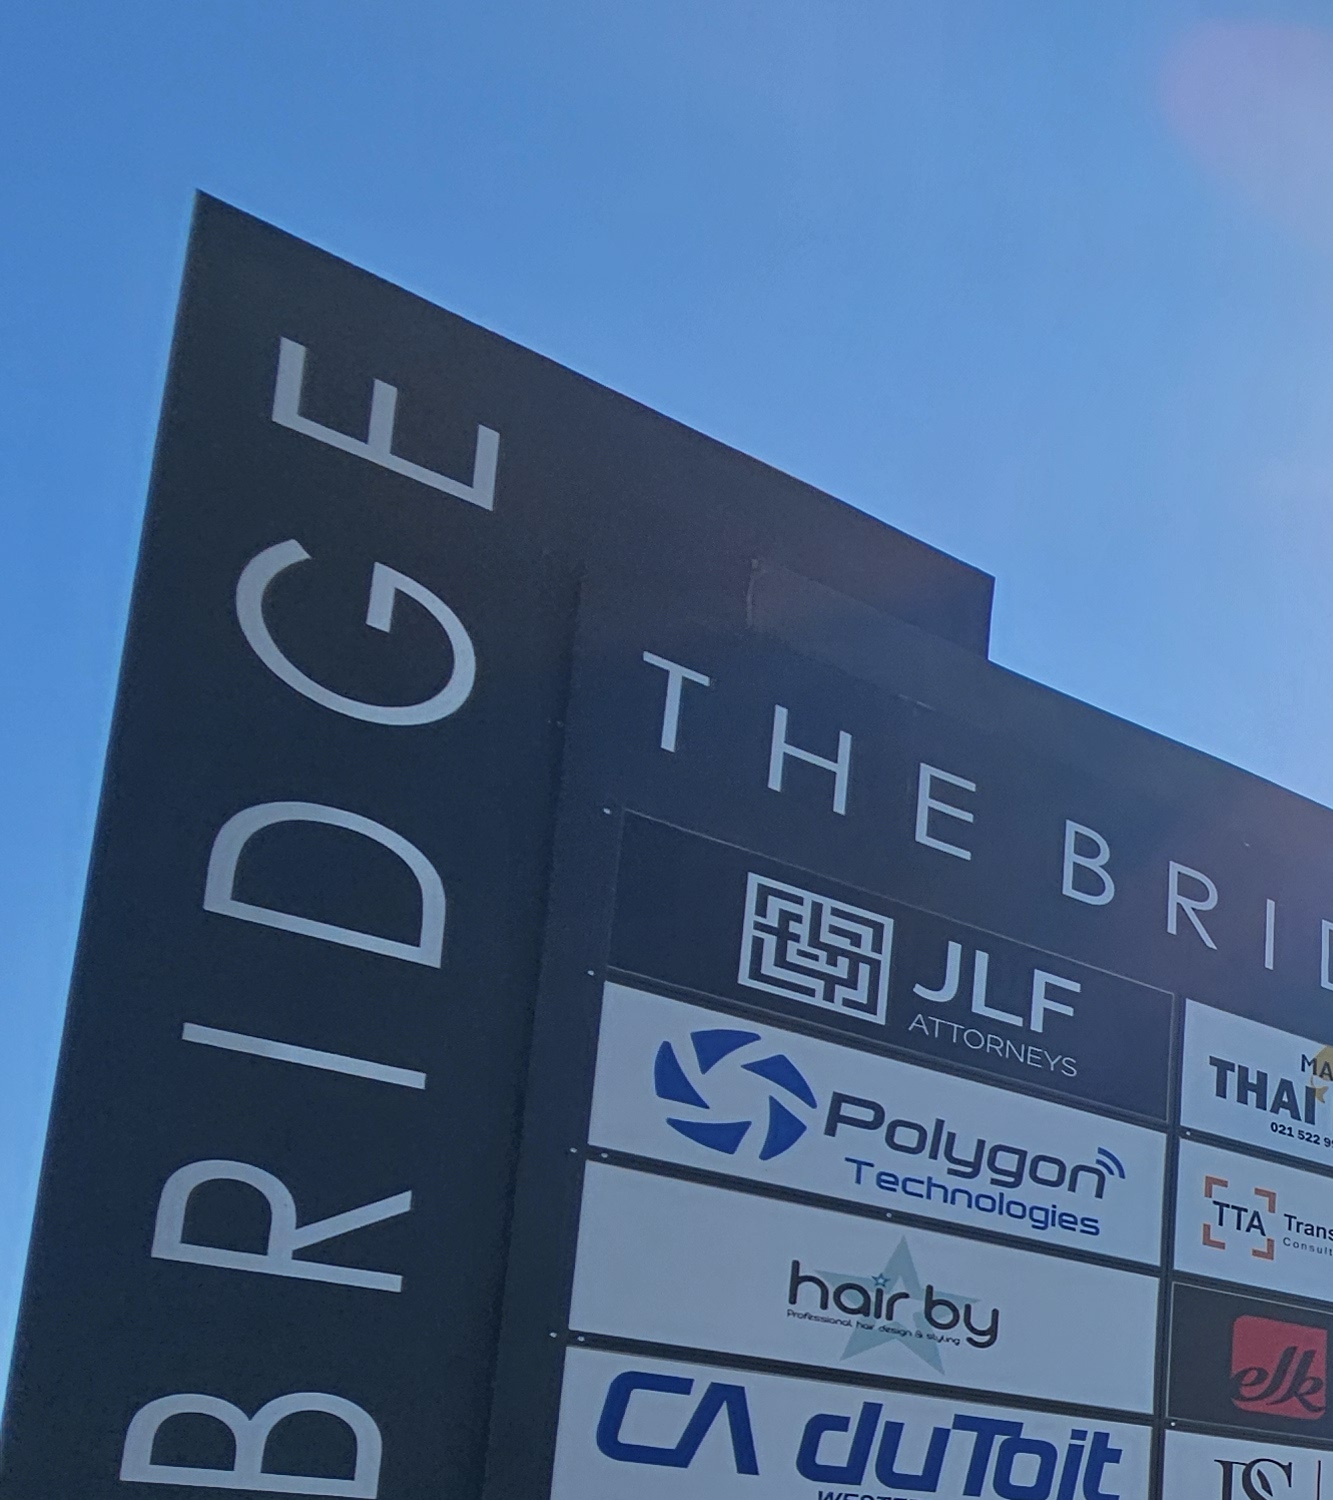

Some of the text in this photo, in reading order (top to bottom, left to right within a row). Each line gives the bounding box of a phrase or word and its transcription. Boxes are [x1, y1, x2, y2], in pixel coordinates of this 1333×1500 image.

[643, 651, 977, 861] THE
[120, 336, 501, 1500] BRIDGE
[913, 941, 1082, 1033] JLF
[908, 1013, 1078, 1078] ATTORNEYS
[1209, 1055, 1316, 1125] THAI
[824, 1091, 1108, 1200] Polygon
[1270, 1121, 1295, 1138] 021
[1298, 1129, 1321, 1146] 522
[845, 1157, 1101, 1236] Technologies
[1212, 1200, 1267, 1237] TTA
[786, 1308, 853, 1329] Professional
[856, 1320, 875, 1331] hair
[878, 1325, 913, 1338] design
[926, 1331, 961, 1346] styling
[788, 1259, 1000, 1349] hair by
